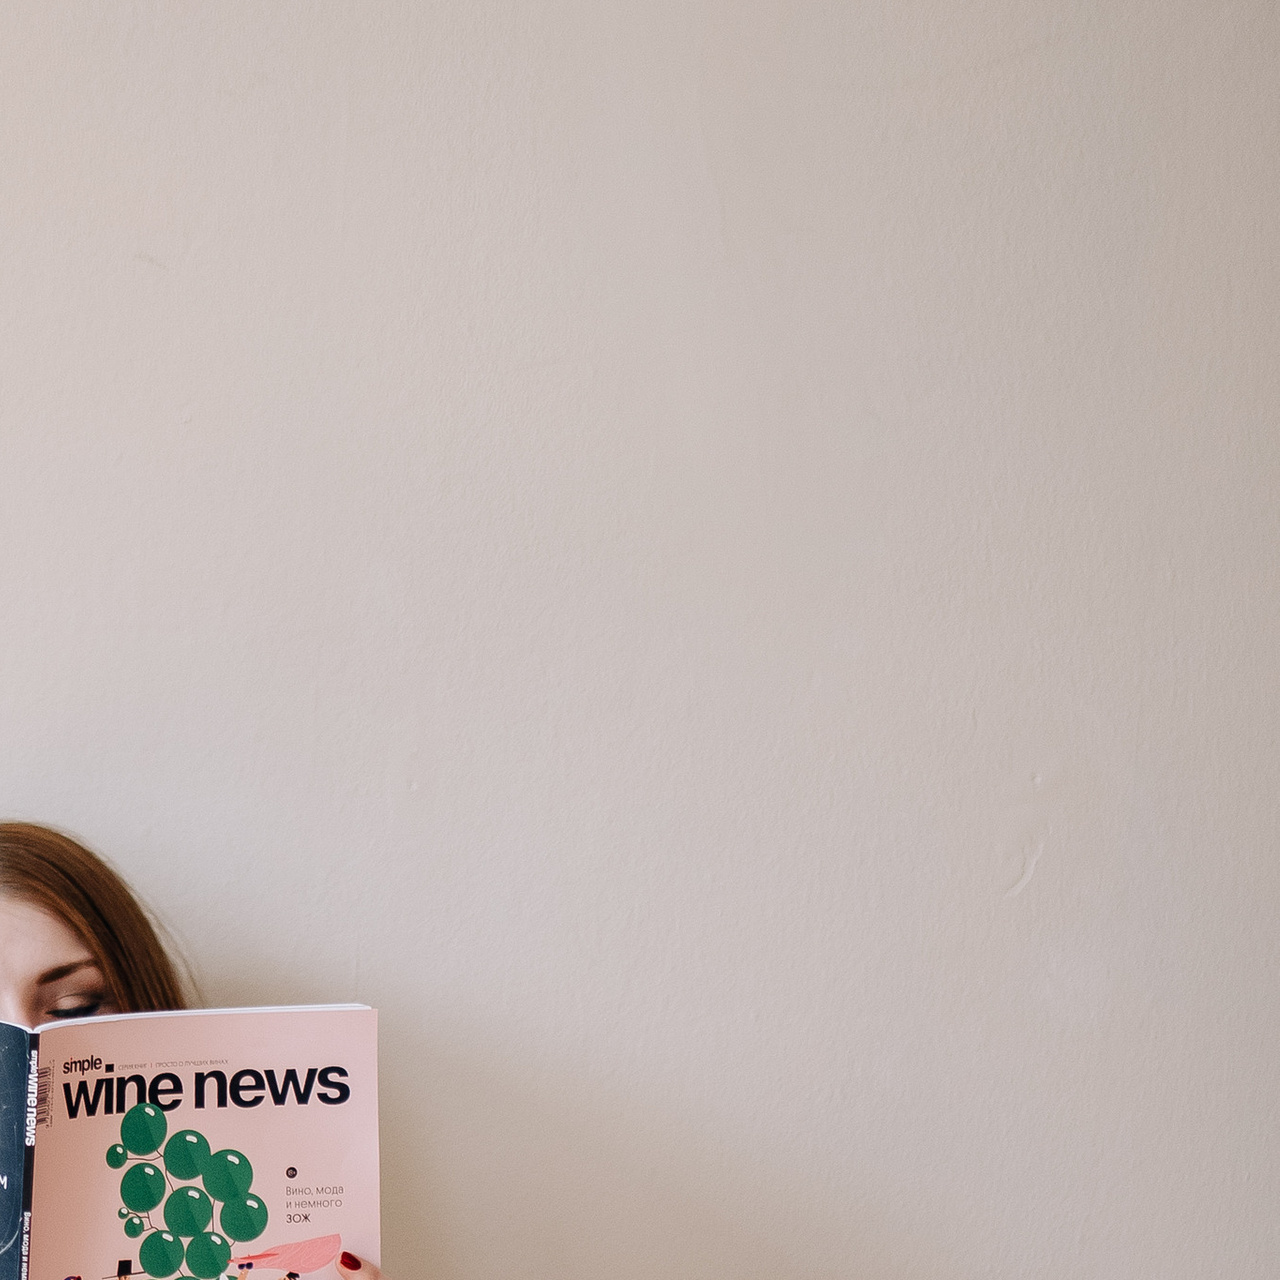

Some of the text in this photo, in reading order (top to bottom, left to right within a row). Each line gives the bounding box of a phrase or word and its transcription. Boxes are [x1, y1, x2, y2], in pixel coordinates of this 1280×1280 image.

[62, 1054, 103, 1076] simple
[27, 1073, 39, 1107] wine
[62, 1064, 183, 1119] wine
[194, 1066, 350, 1109] news
[25, 1107, 37, 1147] news
[285, 1186, 344, 1196] Вино, мода
[286, 1199, 343, 1209] и немного
[23, 1211, 32, 1234] Вино,
[286, 1213, 311, 1223] ЗОЖ
[21, 1234, 29, 1256] мода
